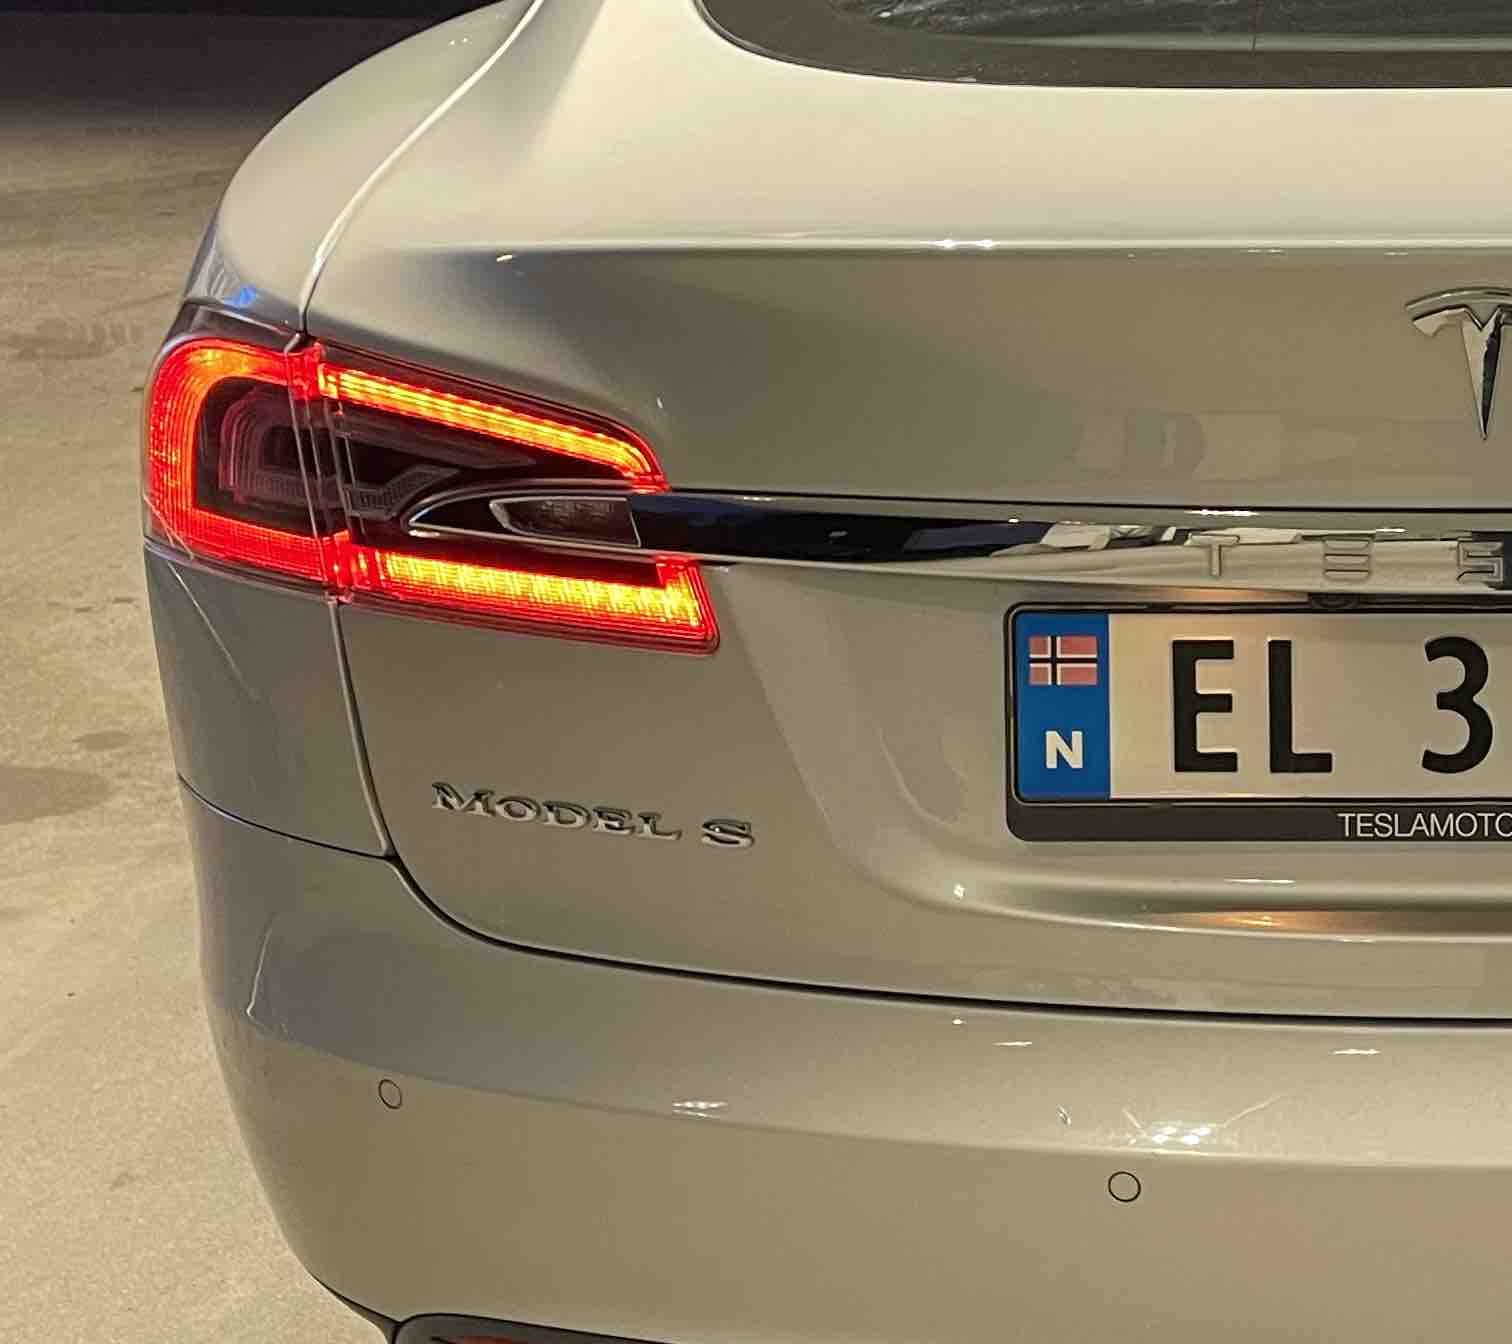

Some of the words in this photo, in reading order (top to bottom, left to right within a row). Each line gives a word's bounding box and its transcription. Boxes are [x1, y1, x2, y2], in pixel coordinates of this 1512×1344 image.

[1172, 640, 1333, 773] EL
[1045, 730, 1083, 769] N
[432, 781, 683, 840] MODEL
[701, 817, 755, 848] S
